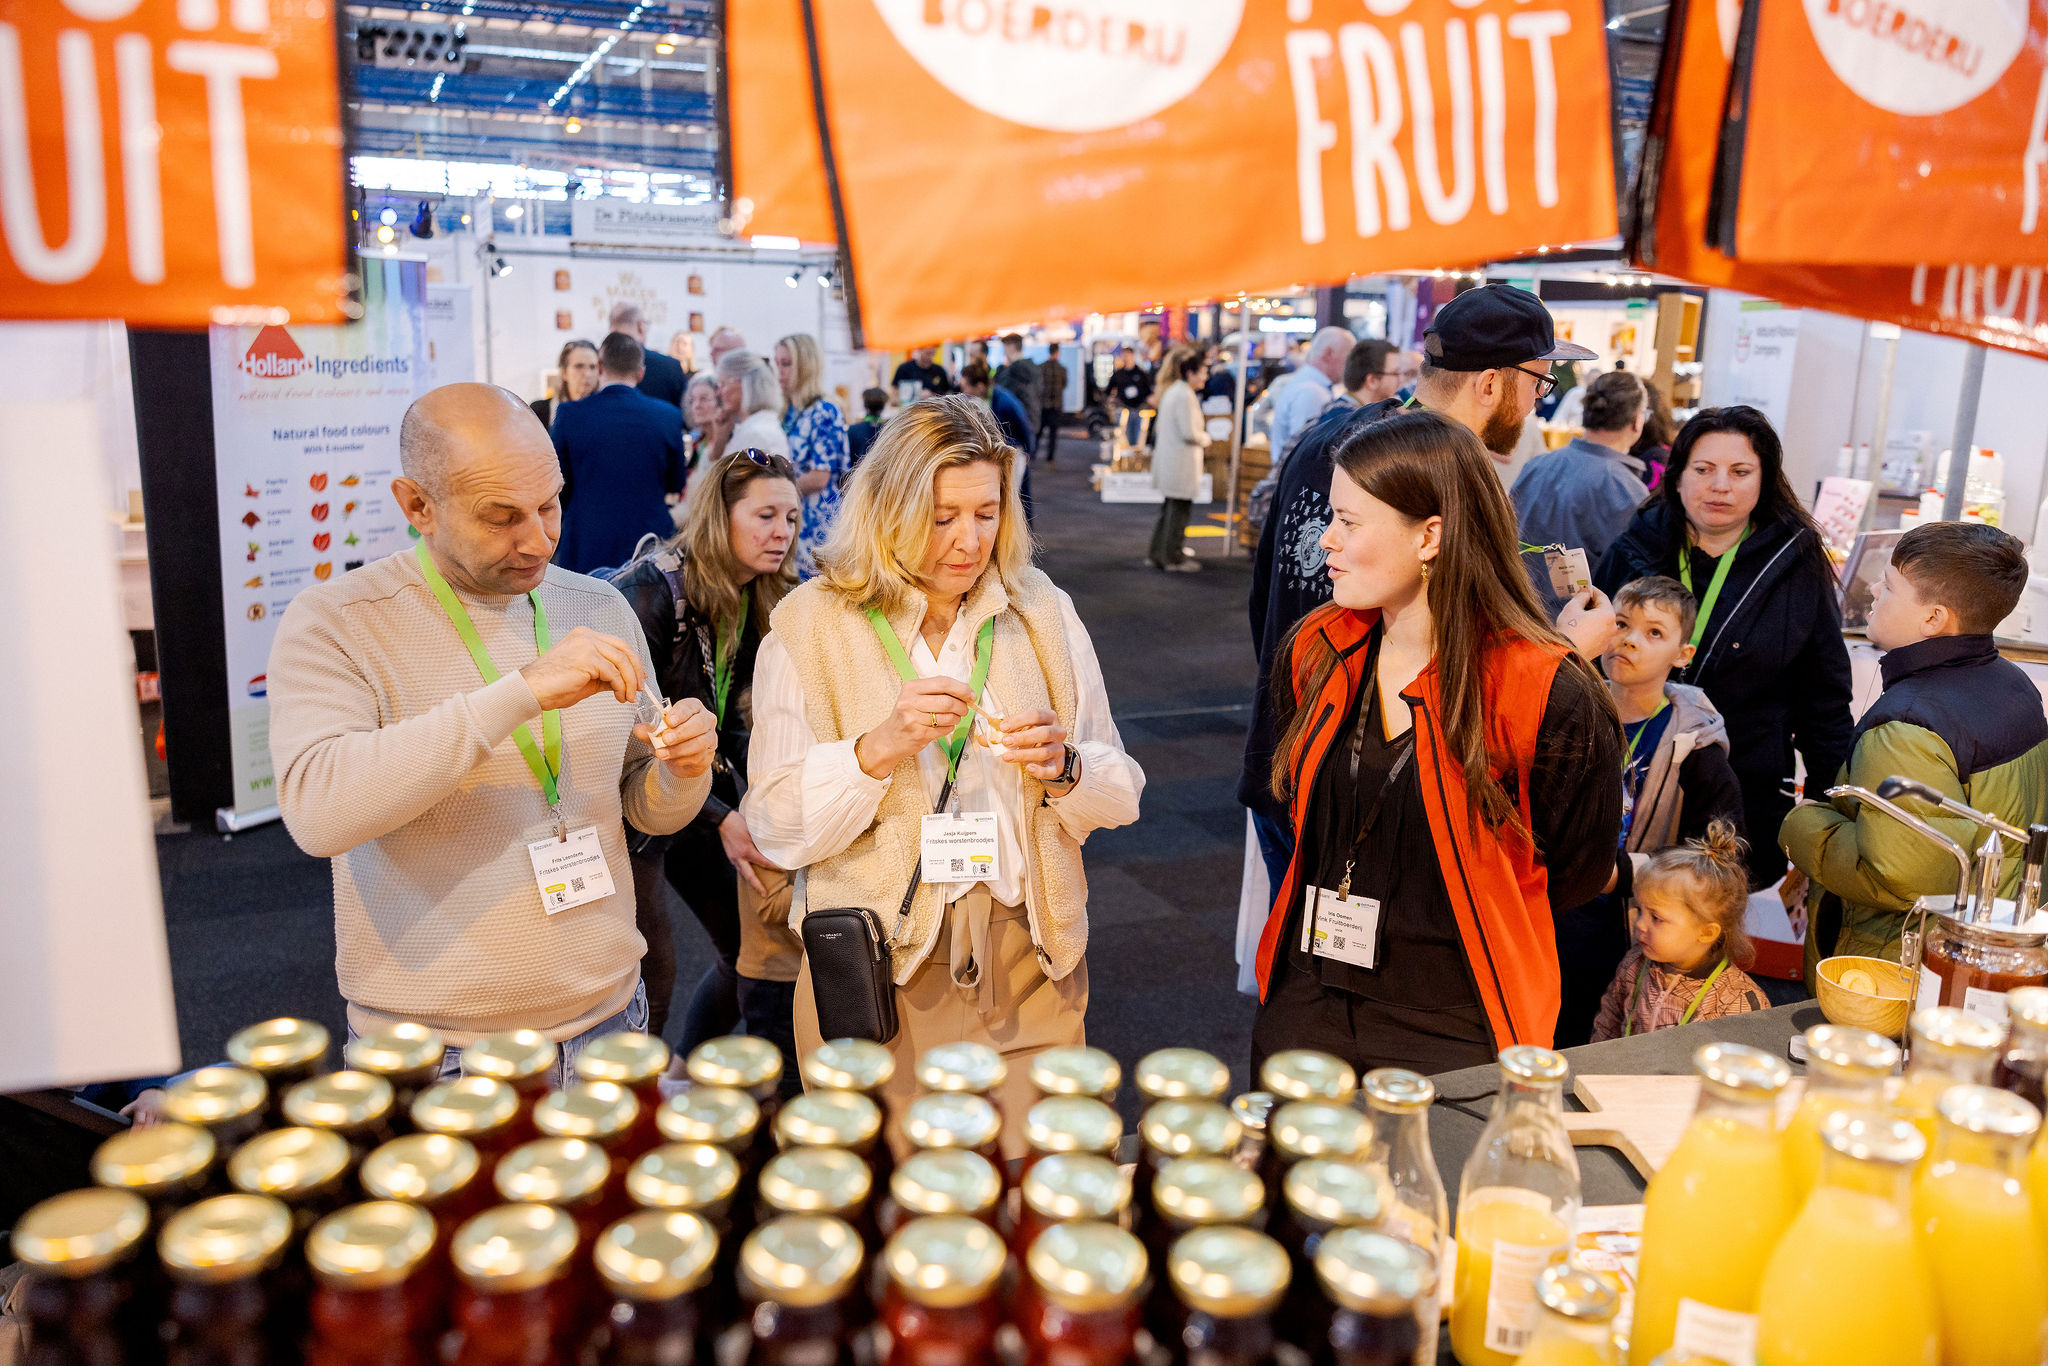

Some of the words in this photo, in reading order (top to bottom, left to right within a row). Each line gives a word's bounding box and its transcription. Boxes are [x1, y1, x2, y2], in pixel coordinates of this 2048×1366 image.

[1285, 10, 1572, 244] FRUIT
[241, 352, 307, 377] Holland
[314, 354, 408, 378] Ingredients
[272, 427, 319, 441] Natural
[322, 426, 347, 439] food
[351, 424, 391, 437] colours
